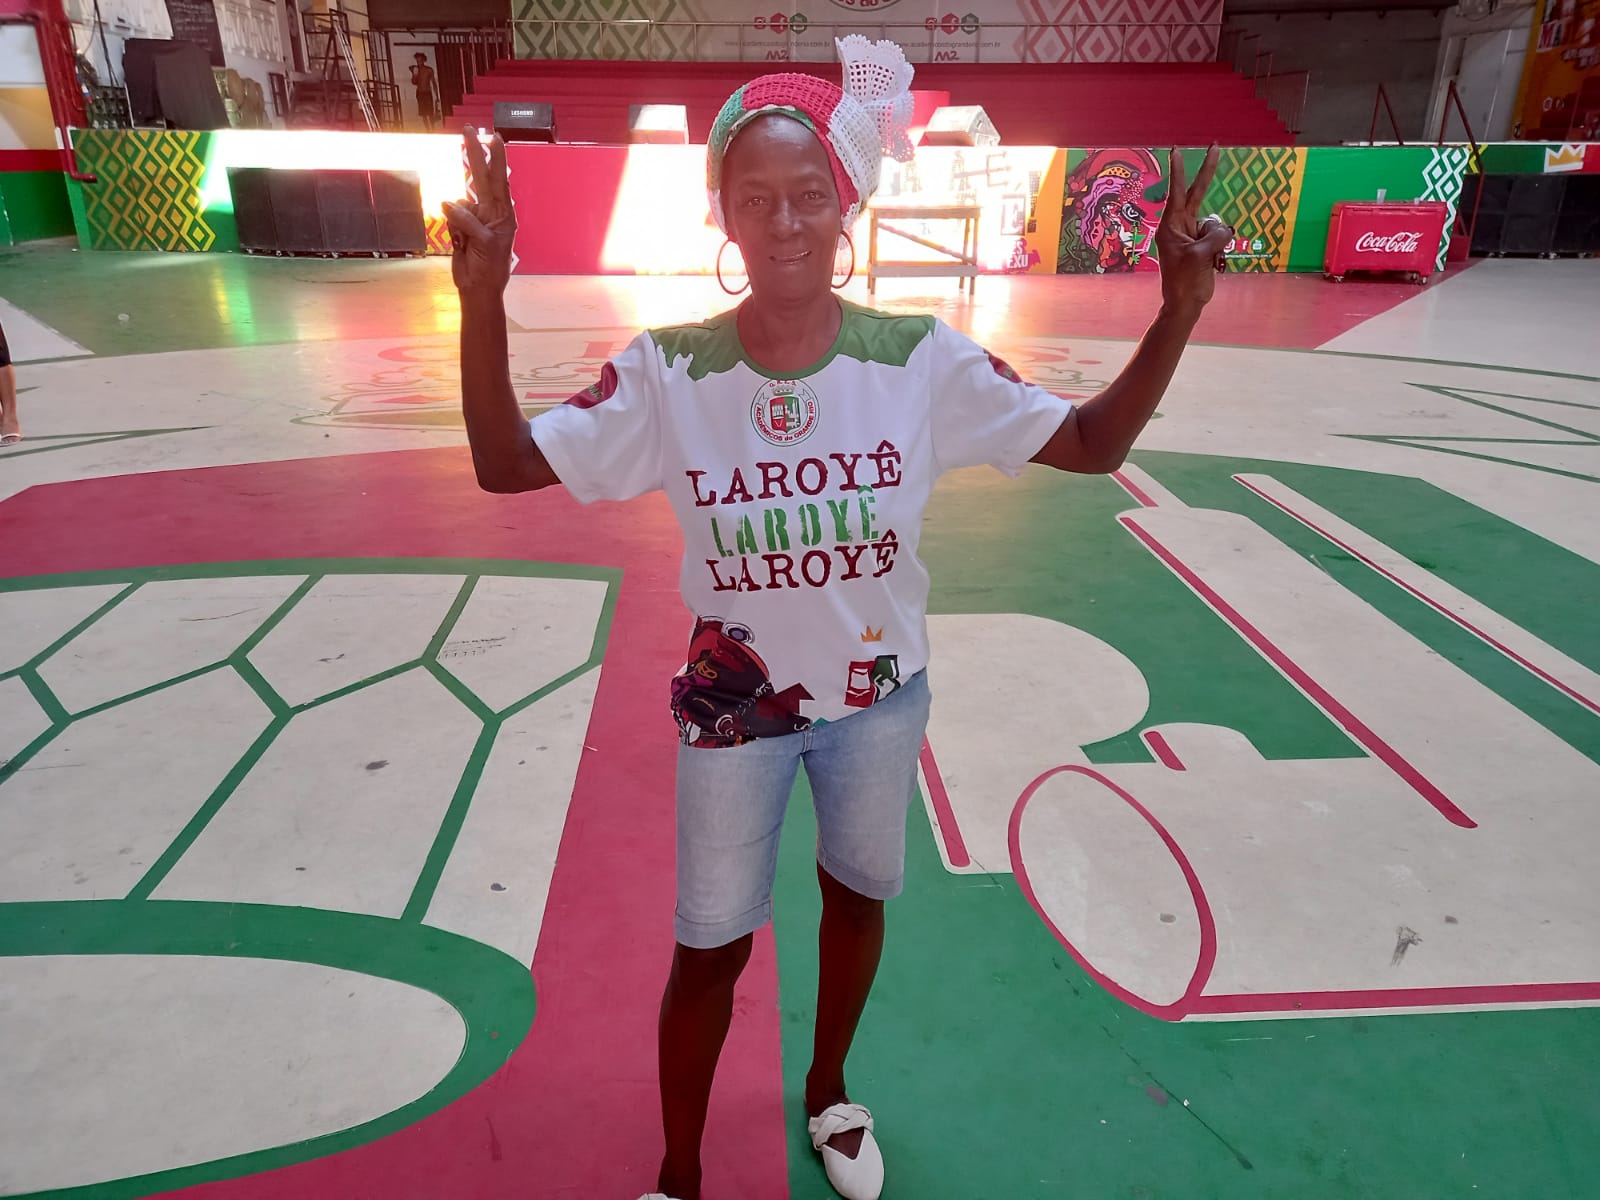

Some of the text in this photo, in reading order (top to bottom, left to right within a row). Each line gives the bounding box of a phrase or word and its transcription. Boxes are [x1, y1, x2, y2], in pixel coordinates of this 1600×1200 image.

[1355, 231, 1424, 253] Coca-Cola
[686, 440, 902, 507] LAROYÊ
[710, 484, 879, 558] LAROYÊ
[705, 529, 899, 592] LAROYÊ
